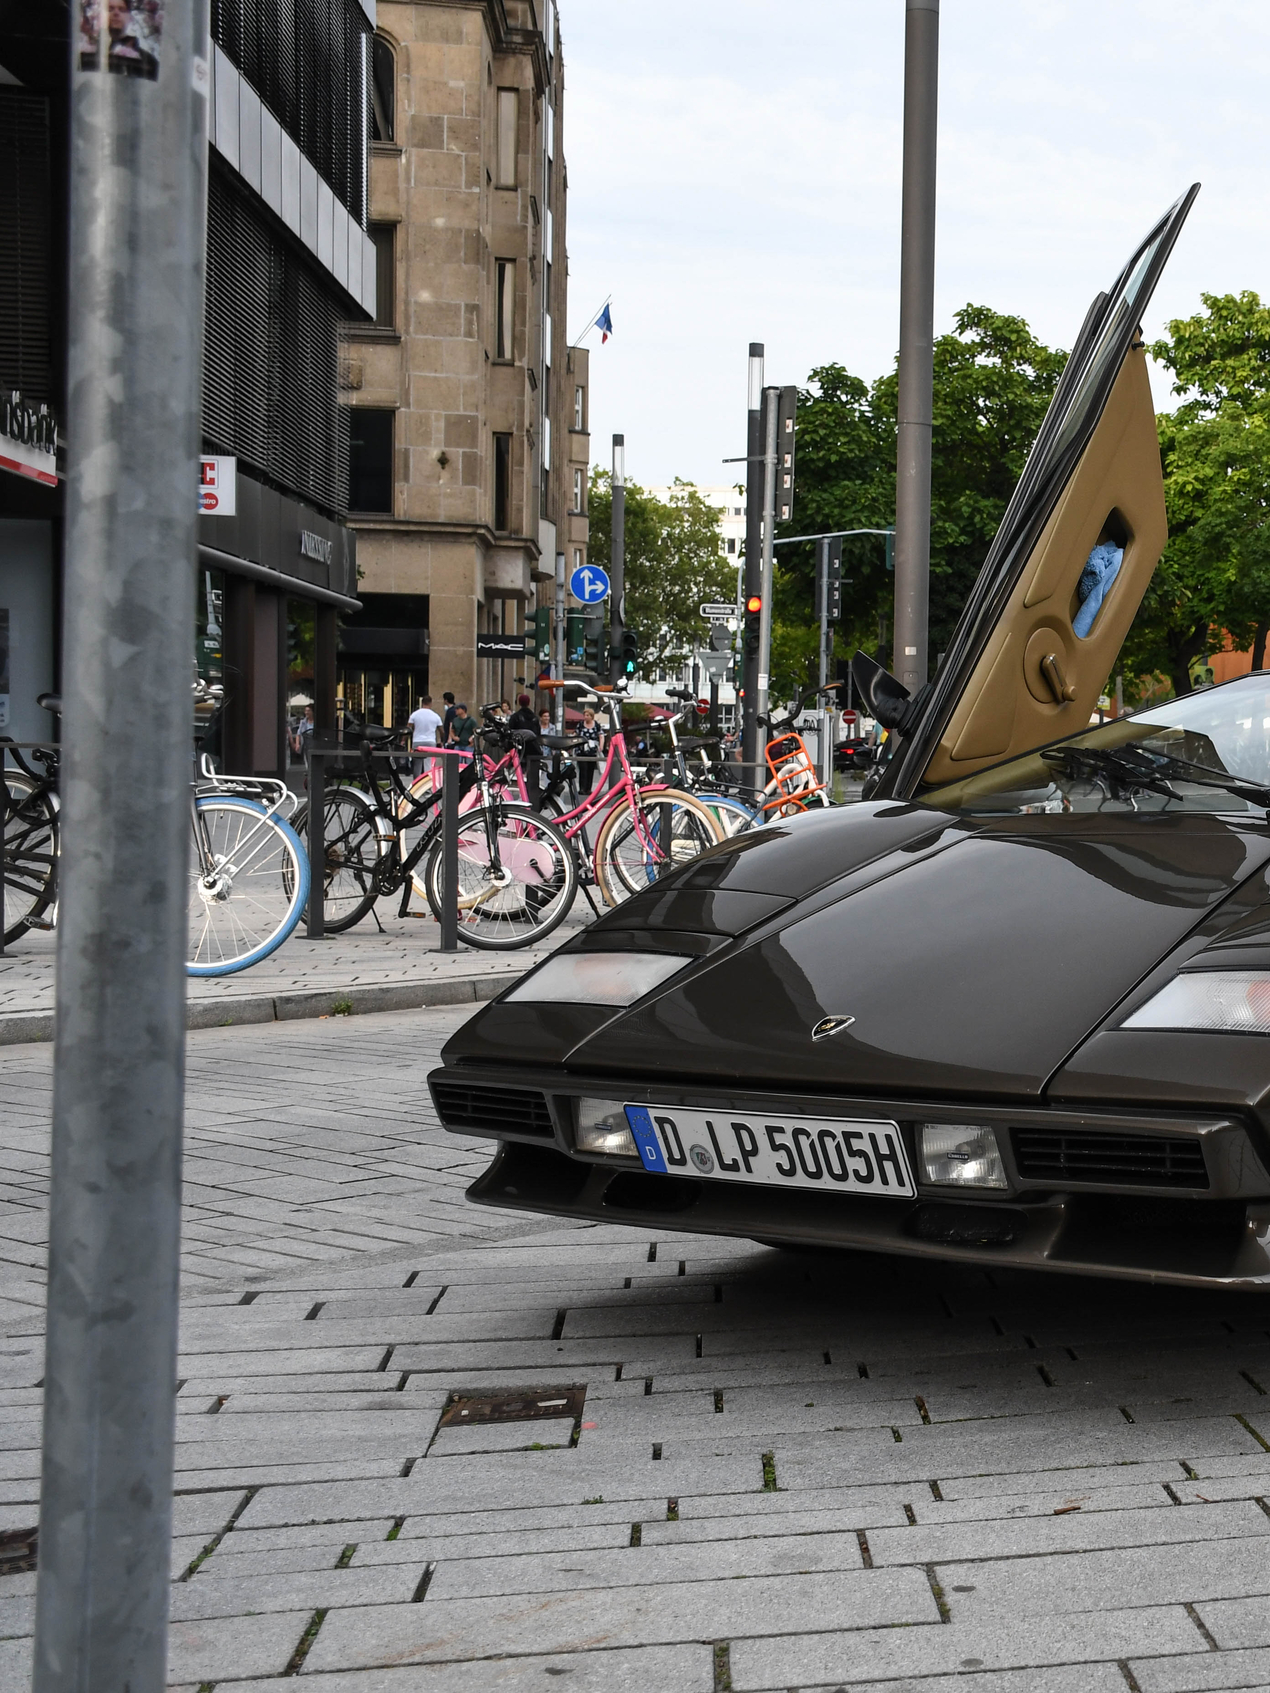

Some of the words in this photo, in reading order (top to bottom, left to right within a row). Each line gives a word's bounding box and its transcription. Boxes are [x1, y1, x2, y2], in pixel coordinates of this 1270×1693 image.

[478, 642, 524, 651] MAC
[645, 1146, 657, 1160] D
[654, 1116, 687, 1166] D
[705, 1120, 758, 1173] LP
[765, 1125, 906, 1188] 5005H
